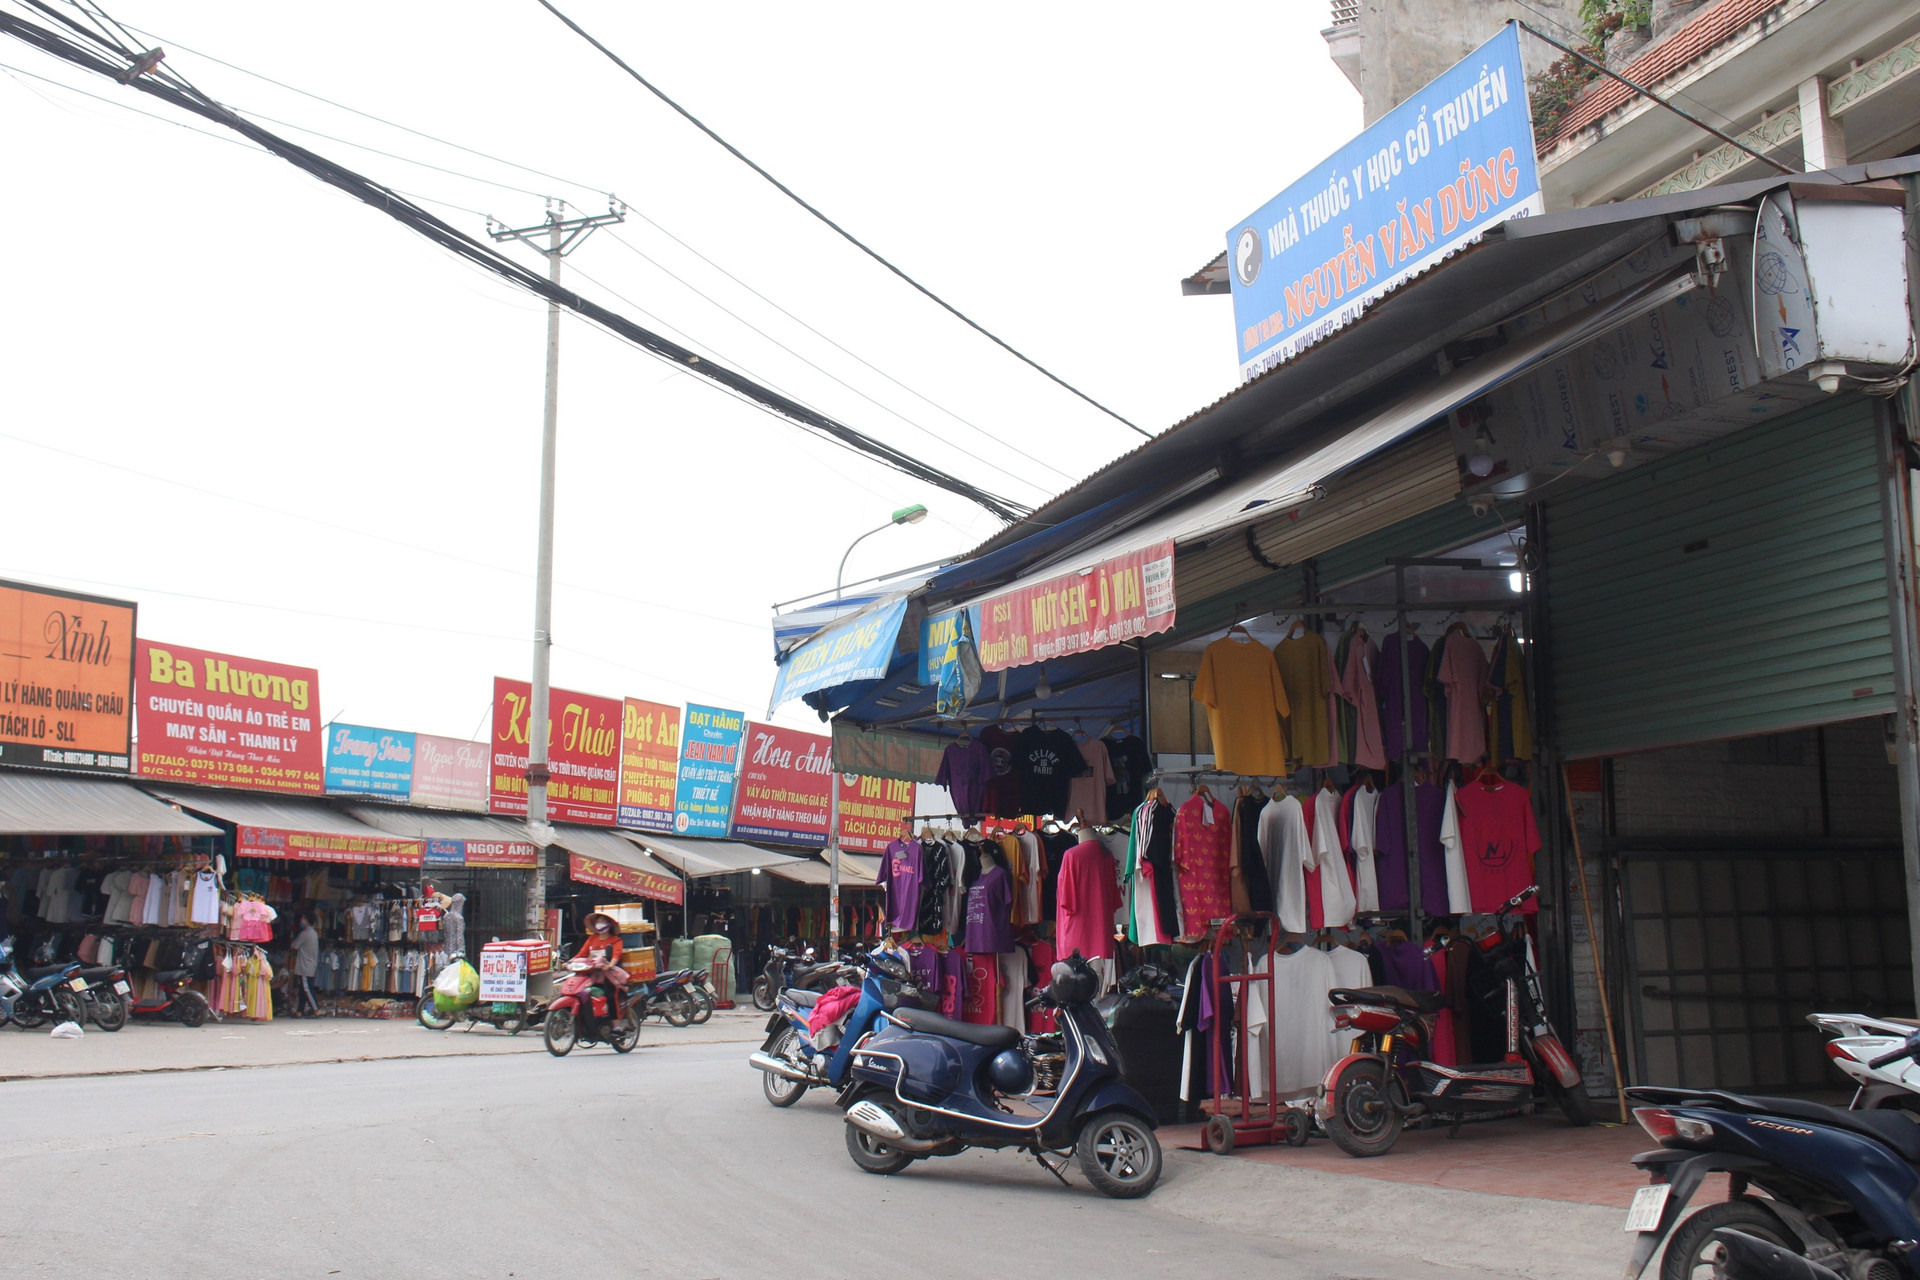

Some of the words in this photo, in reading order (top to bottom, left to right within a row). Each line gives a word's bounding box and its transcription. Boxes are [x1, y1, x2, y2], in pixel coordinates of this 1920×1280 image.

[1268, 208, 1300, 259] NHÀ
[1300, 170, 1350, 236] THUỐC
[1352, 165, 1363, 201] Y
[1367, 140, 1402, 194] HỌC
[1405, 104, 1430, 166] CỔ
[1432, 64, 1508, 147] TRUYỀN
[1284, 223, 1375, 328] NGUYỄN
[1378, 197, 1434, 268] VĂN
[1438, 146, 1518, 236] DŨNG
[1294, 332, 1314, 352] NINH
[994, 601, 1012, 624] CSSX
[1032, 588, 1057, 635] MỨT
[1060, 584, 1088, 628] SEN
[1112, 566, 1141, 612] MAI
[44, 610, 112, 667] Xinh
[148, 648, 195, 688] Ba
[204, 658, 308, 710] Hương
[5, 679, 18, 703] LÝ
[22, 682, 52, 708] HÀNG
[56, 684, 92, 712] QUẢNG
[96, 692, 123, 716] CHÂU
[0, 712, 28, 737] TÁCH
[32, 714, 46, 738] LÔ
[56, 721, 75, 742] SLL
[150, 696, 204, 718] CHUYÊN
[246, 708, 262, 726] ÁO
[266, 711, 288, 730] TRẺ
[292, 718, 310, 732] EM
[624, 704, 653, 750] Đạt
[656, 712, 678, 747] An
[690, 711, 710, 728] ĐẠT
[166, 722, 196, 740] MAY
[238, 732, 280, 750] THANH
[284, 736, 298, 752] LÝ
[562, 703, 616, 757] Thảo
[422, 742, 454, 773] Ngọc
[457, 742, 484, 768] Ánh
[684, 740, 705, 760] JEAN
[707, 744, 724, 762] NAM
[752, 732, 792, 768] Hoa
[1029, 749, 1060, 764] CELINE
[142, 753, 188, 767] ĐT/ZALO:
[191, 759, 214, 770] 0375
[218, 761, 234, 772] 173
[261, 766, 283, 778] 0364
[286, 768, 301, 779] 997
[304, 770, 320, 781] 644
[624, 770, 654, 786] CHUYÊN
[1034, 766, 1053, 775] PARIS
[208, 773, 228, 782] KHU
[230, 775, 252, 784] SINH
[278, 780, 301, 789] MINH
[303, 782, 320, 791] THU
[627, 789, 653, 806] PHÔNG
[660, 792, 670, 810] BỘ
[746, 784, 760, 796] VÁY
[760, 785, 770, 799] ÁO
[772, 787, 786, 802] THỜI
[788, 792, 808, 805] TRANG
[809, 793, 819, 806] GIÁ
[820, 794, 828, 807] RẺ
[742, 802, 762, 820] NHẬN
[762, 806, 775, 822] ĐẶT
[776, 805, 794, 822] HÀNG
[796, 811, 812, 822] THEO
[812, 809, 827, 826] MẪU
[845, 818, 865, 834] TÁCH
[867, 820, 877, 835] LÔ
[878, 823, 891, 837] GIÁ
[468, 843, 506, 856] NGỌC
[508, 843, 534, 856] ÁNH
[573, 857, 622, 880] Kim
[629, 871, 678, 893] Thảo
[483, 960, 495, 975] Hay
[1746, 1118, 1814, 1135] VISION
